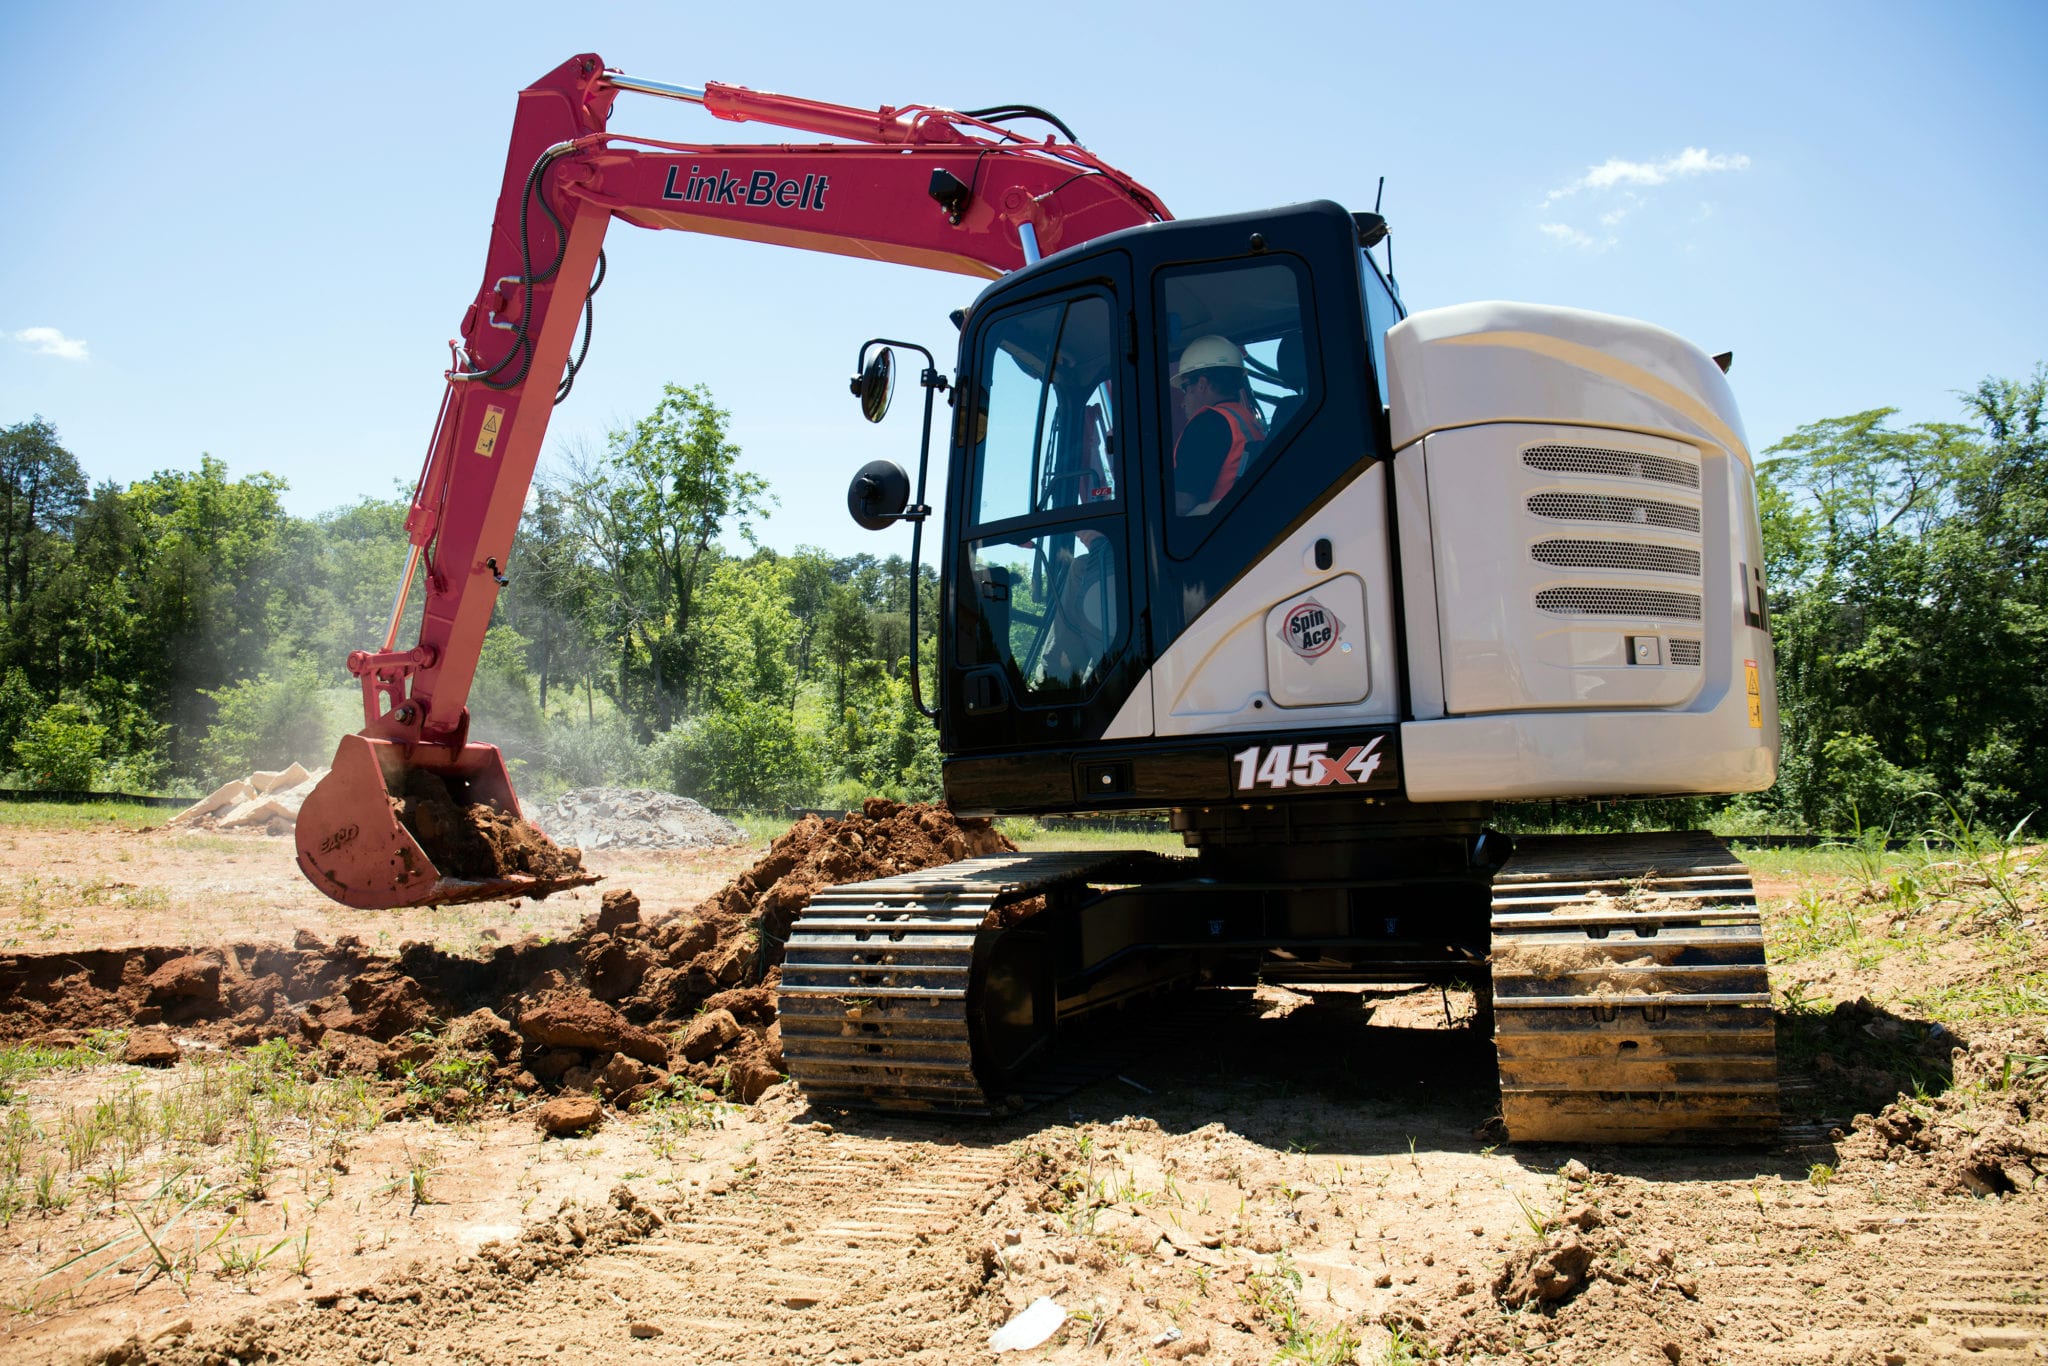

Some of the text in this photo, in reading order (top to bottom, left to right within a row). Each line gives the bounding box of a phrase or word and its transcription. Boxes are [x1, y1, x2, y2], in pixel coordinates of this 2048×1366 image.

[662, 164, 829, 211] Link-Belt
[1291, 610, 1325, 634] Spin
[1303, 627, 1332, 649] Ace
